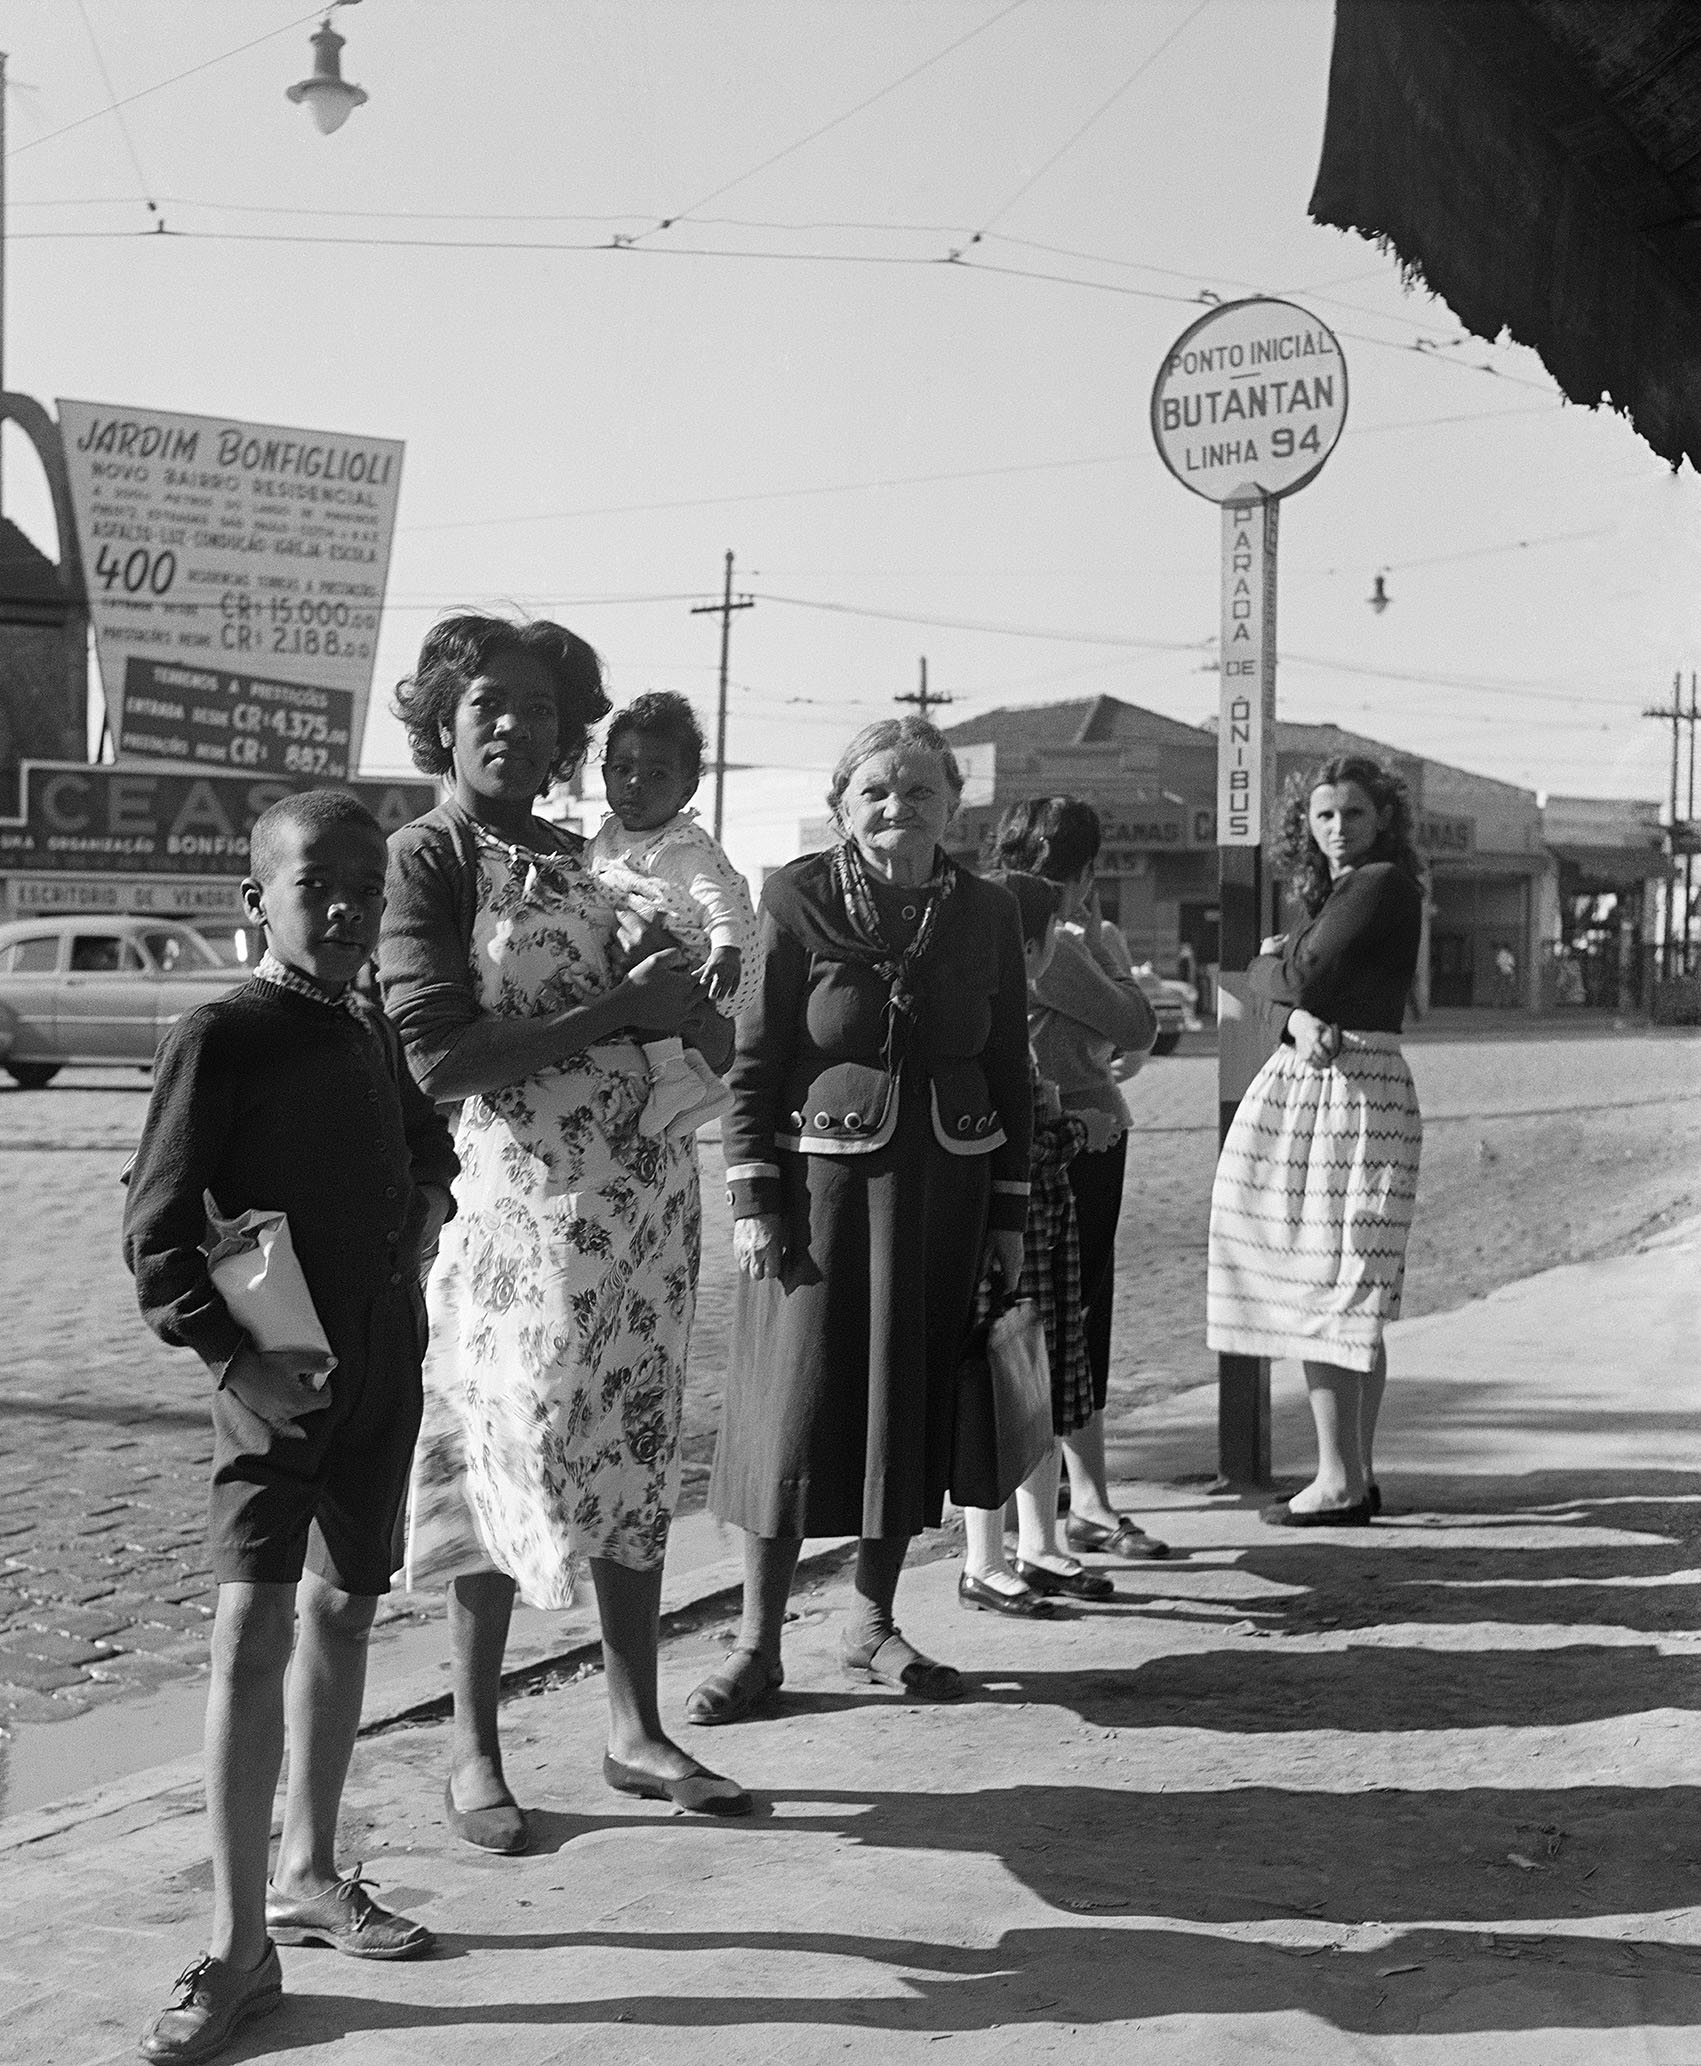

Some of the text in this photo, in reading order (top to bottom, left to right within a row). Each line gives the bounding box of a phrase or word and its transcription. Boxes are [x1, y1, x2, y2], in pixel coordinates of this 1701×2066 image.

[1168, 329, 1334, 377] PONTO INICIAL
[1163, 374, 1334, 432] BUTANTAN
[77, 418, 393, 486] JARDIM BONFIGLIOLI
[1186, 423, 1321, 471] LINHA 94
[91, 461, 379, 509] NOVO BAIRRO RESIDENCIAL
[95, 543, 178, 595] 400
[1225, 508, 1257, 836] PARADA DE ÔNIBUS
[42, 773, 415, 838] CEASA
[0, 833, 36, 852] UMA
[46, 834, 156, 855] ORGANIZAÇÃO
[134, 887, 154, 908] DE
